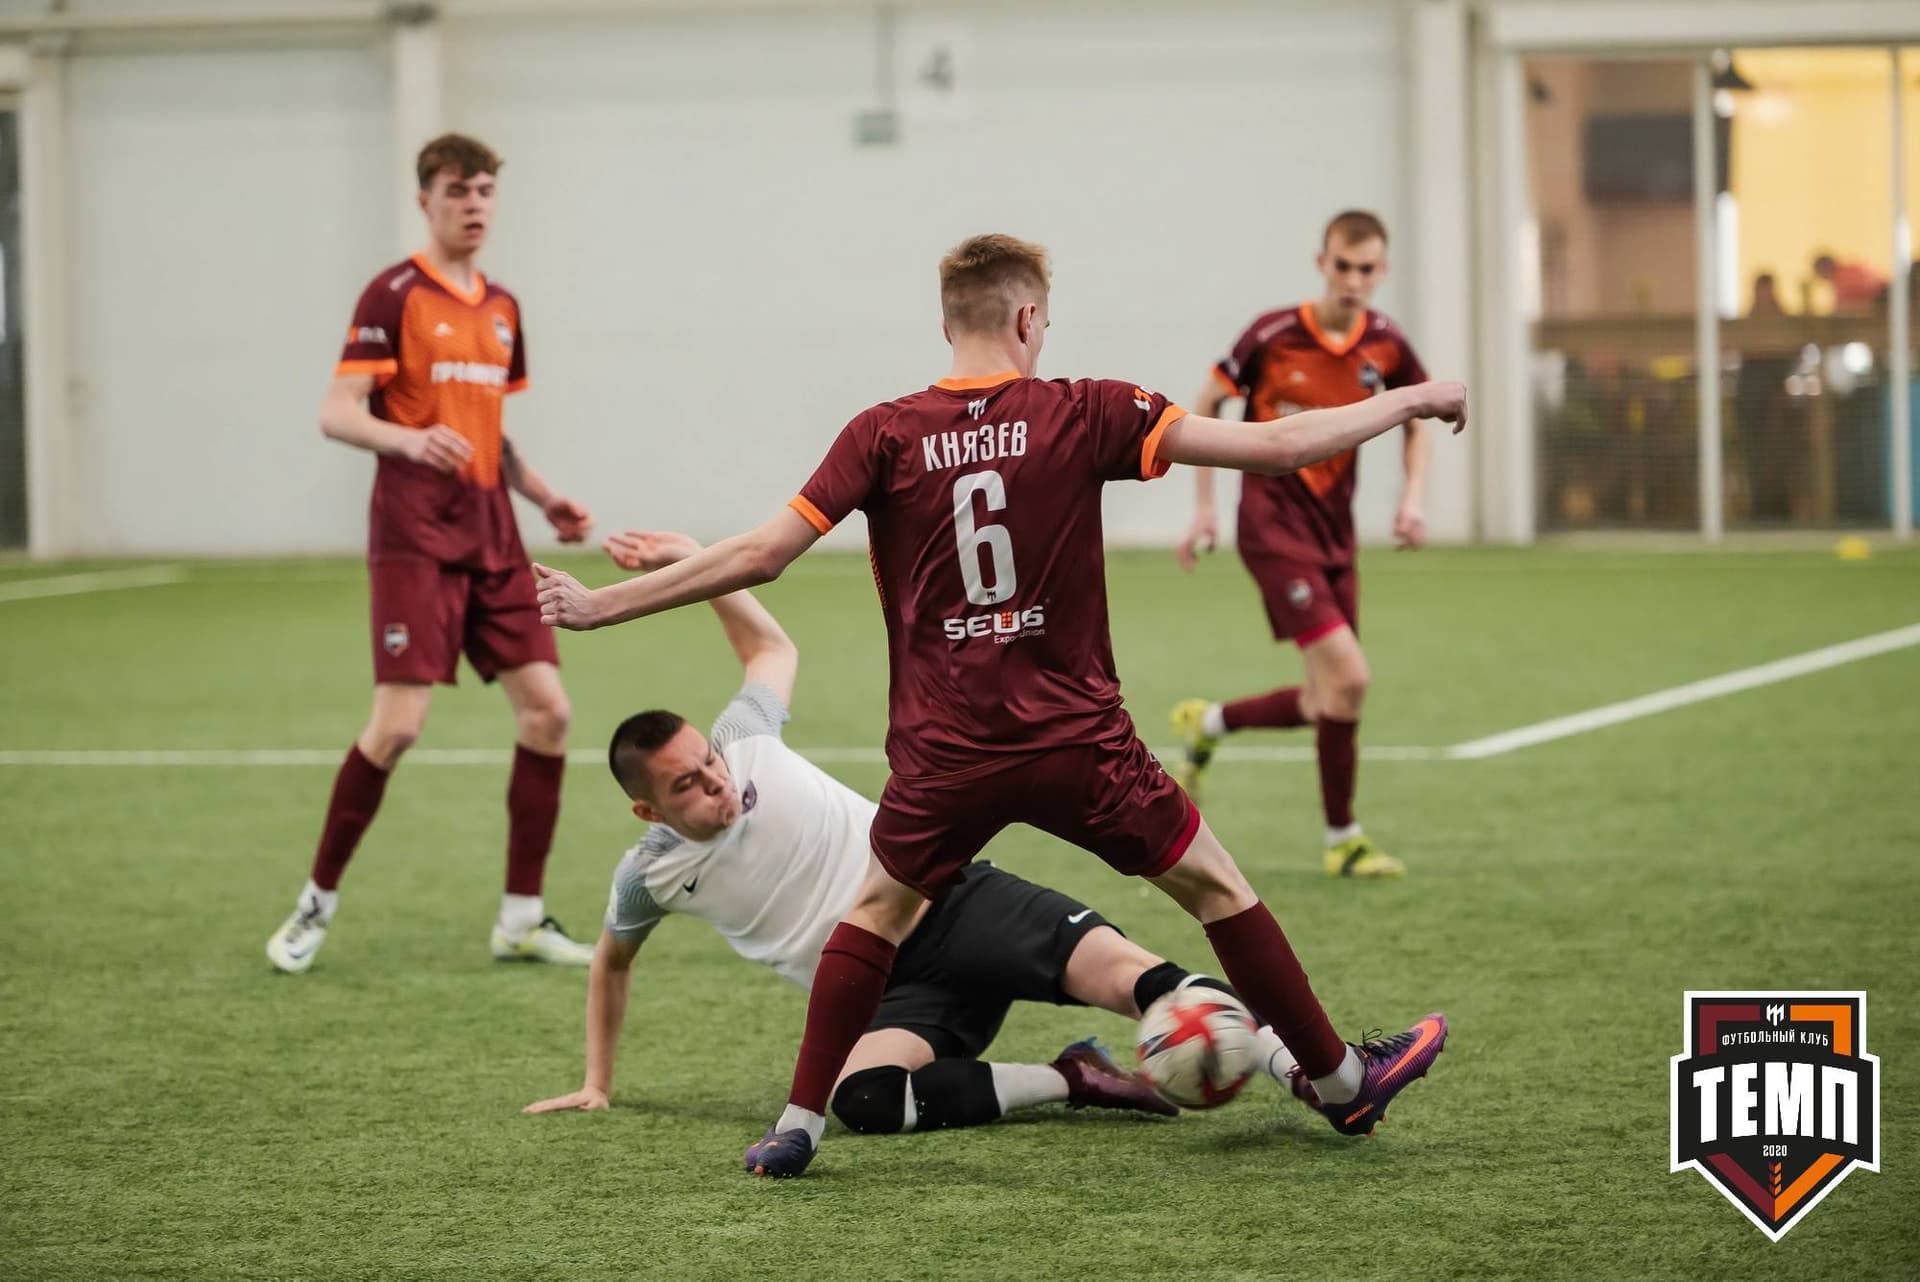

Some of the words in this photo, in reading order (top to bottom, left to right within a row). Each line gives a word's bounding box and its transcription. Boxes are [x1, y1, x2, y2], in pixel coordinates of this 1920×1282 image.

[922, 420, 1028, 472] КНЯЗЕВ
[952, 470, 1017, 606] 6
[943, 605, 1045, 640] SEUS
